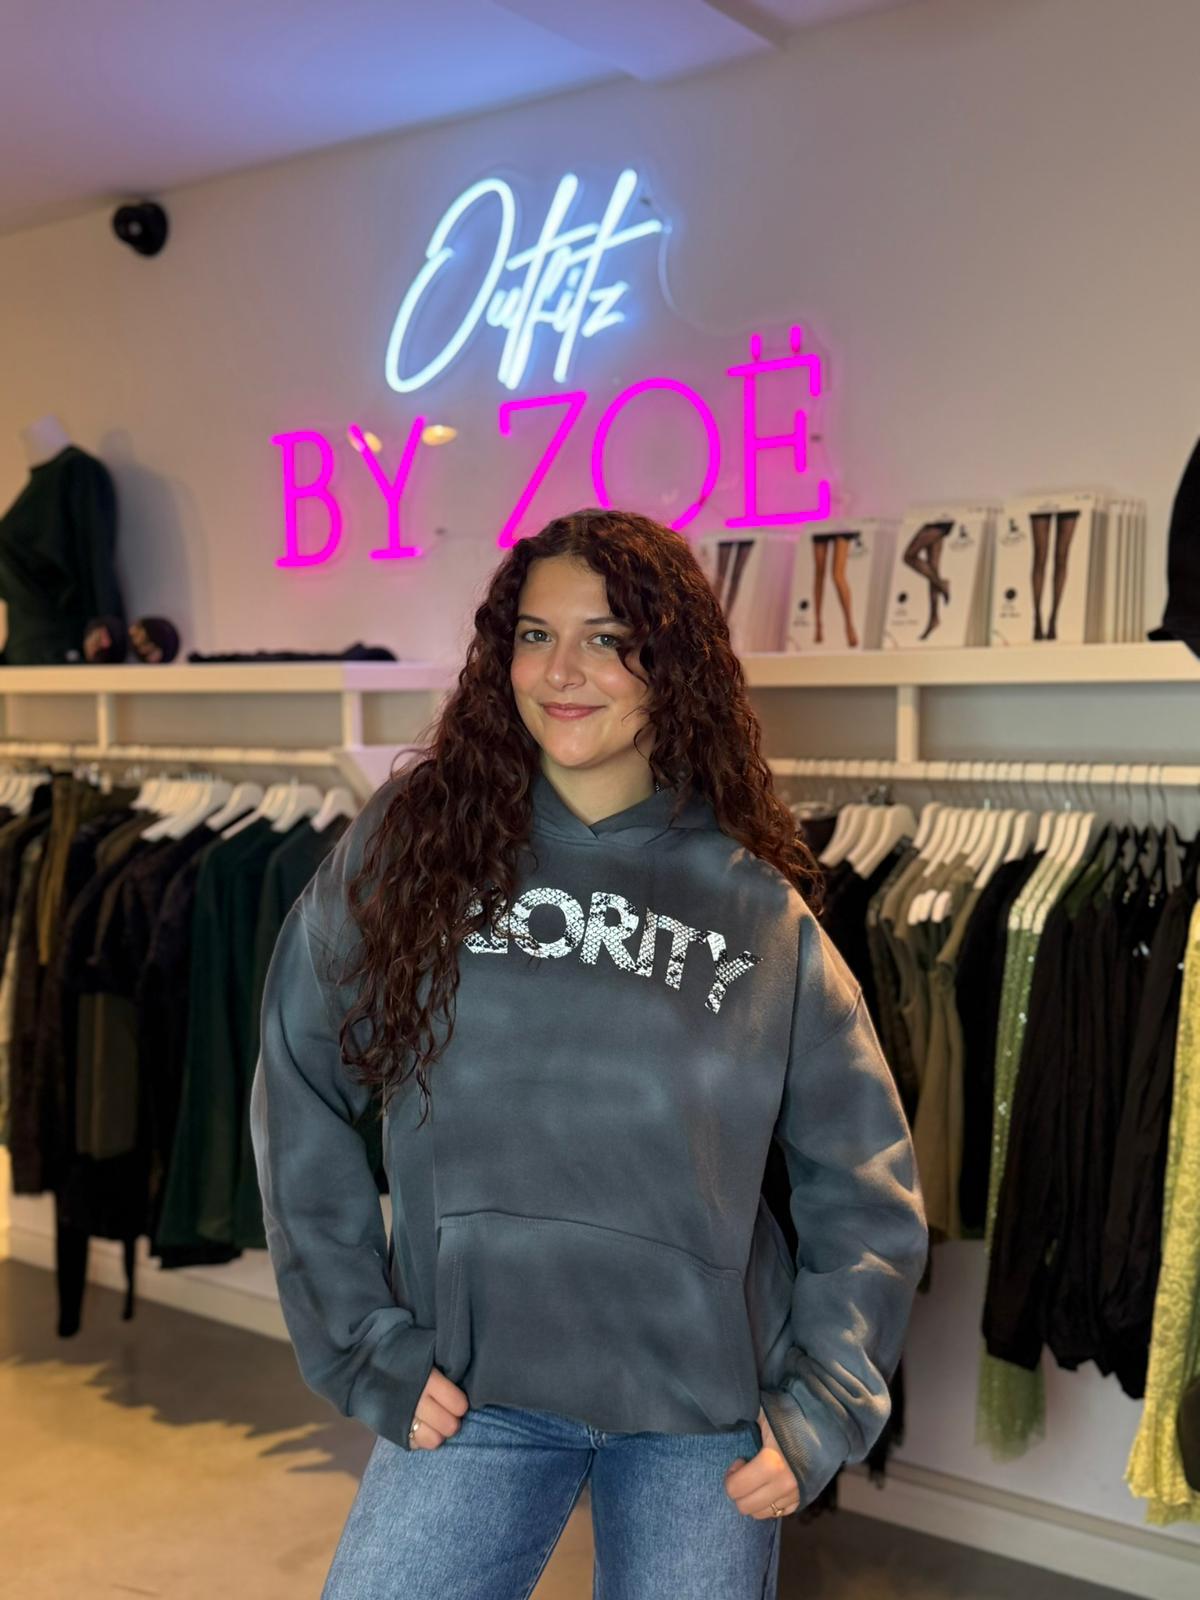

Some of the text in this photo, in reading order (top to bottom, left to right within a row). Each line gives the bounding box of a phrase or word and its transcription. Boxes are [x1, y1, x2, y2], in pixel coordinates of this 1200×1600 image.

[385, 168, 662, 393] Outfitz
[271, 325, 831, 569] BY ZOË
